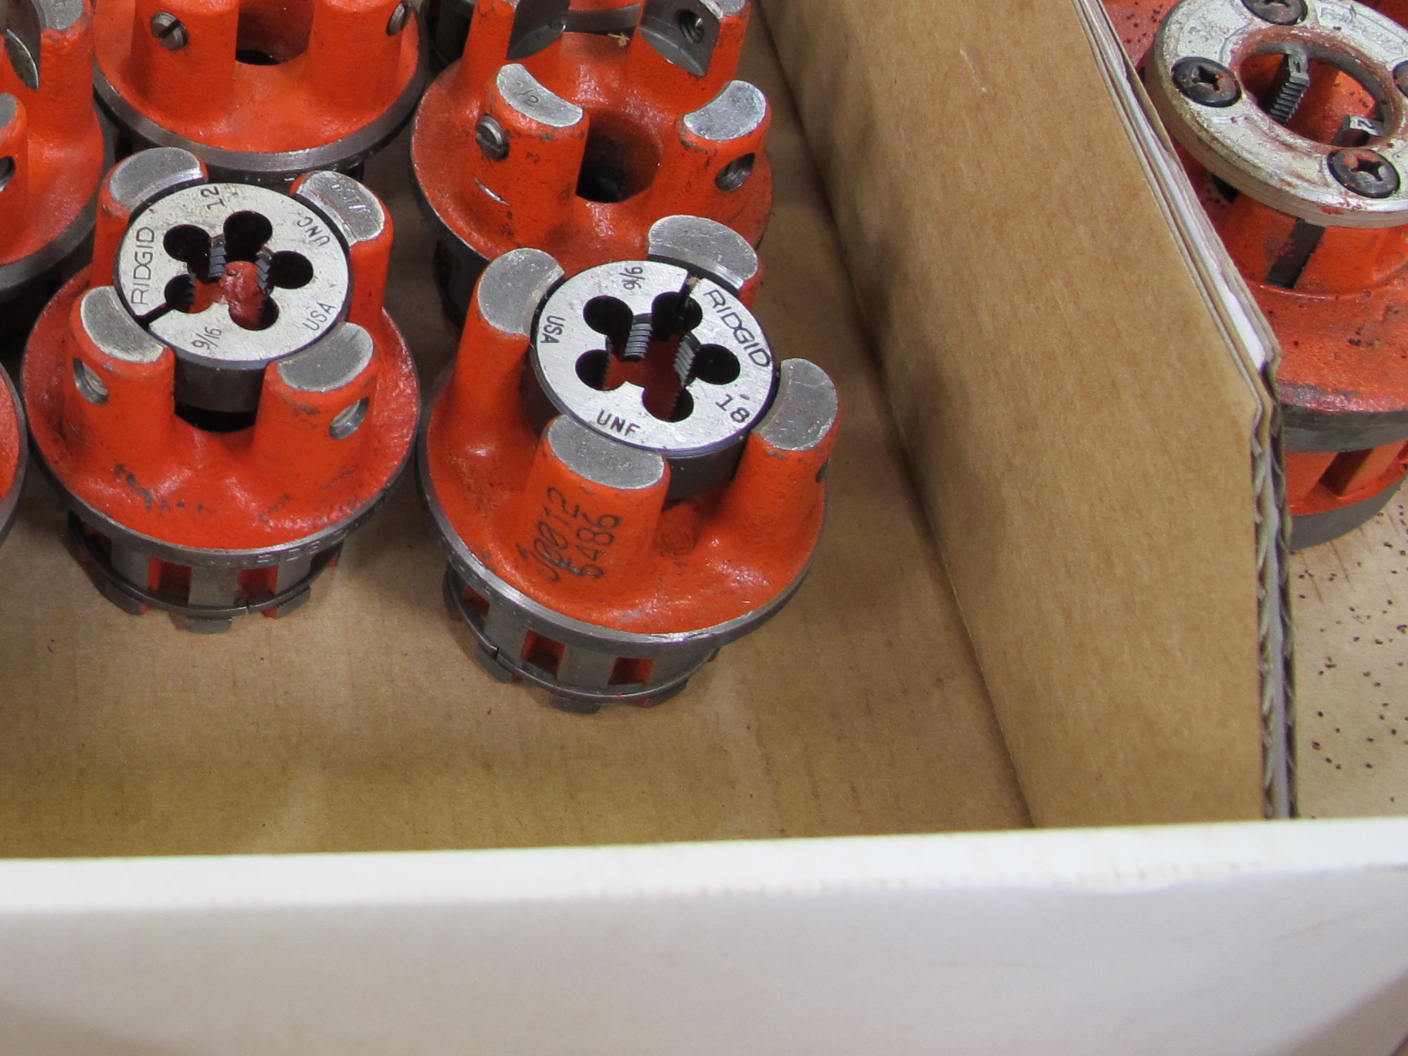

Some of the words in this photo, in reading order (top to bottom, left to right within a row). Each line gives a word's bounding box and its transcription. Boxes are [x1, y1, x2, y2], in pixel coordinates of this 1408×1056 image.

[199, 185, 225, 211] 12
[296, 215, 331, 247] UNC
[131, 225, 155, 307] RIDGID
[618, 266, 644, 291] 9/16
[302, 302, 336, 333] USA
[540, 315, 565, 344] USA
[703, 289, 772, 368] RIDGID
[192, 326, 223, 350] 9/16
[596, 408, 640, 437] UNF
